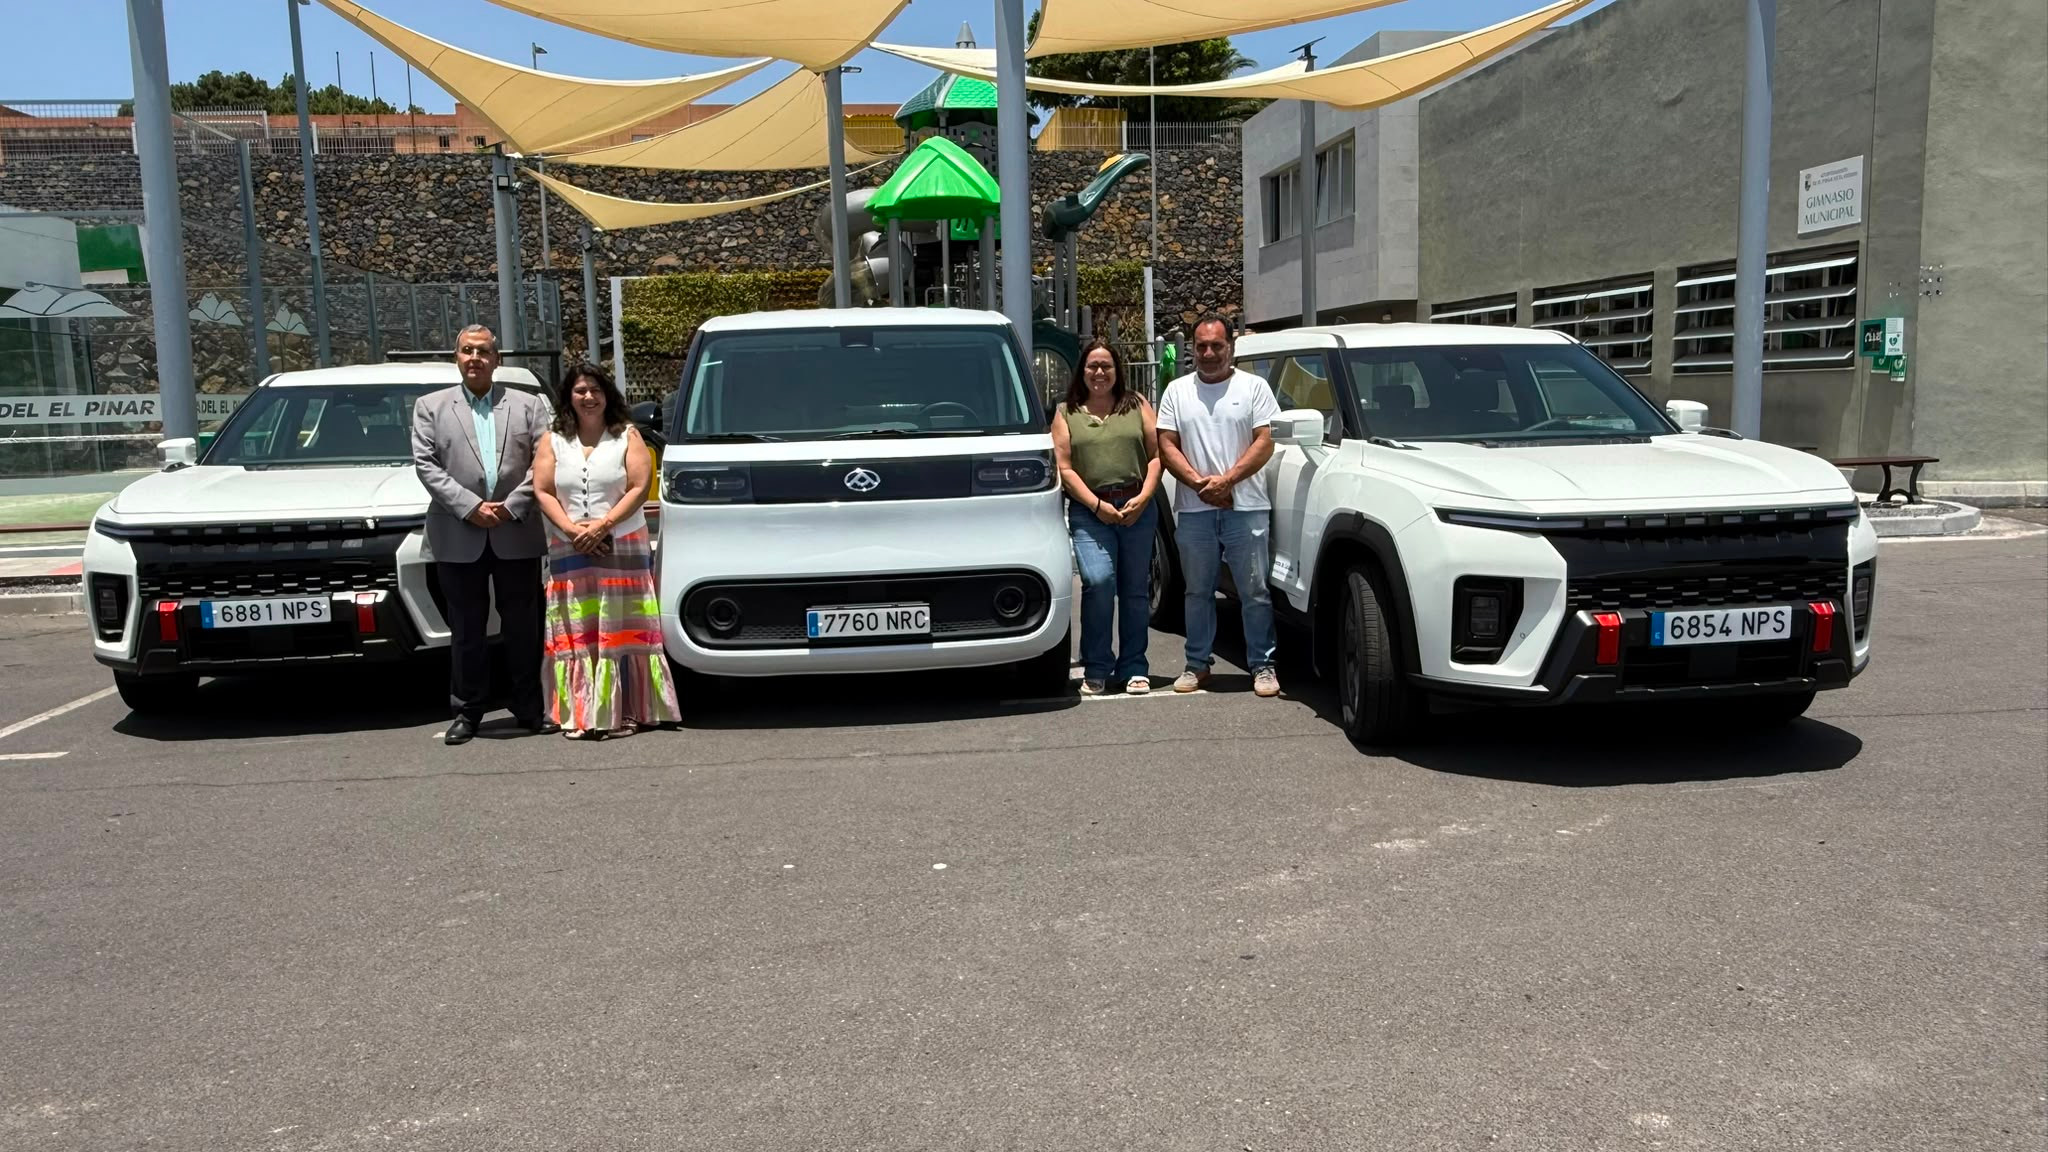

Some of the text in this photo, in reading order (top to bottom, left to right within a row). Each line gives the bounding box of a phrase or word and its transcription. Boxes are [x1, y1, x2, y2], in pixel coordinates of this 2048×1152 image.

[1806, 188, 1854, 209] GIMNASIO
[1804, 206, 1855, 225] MUNICIPAL
[48, 402, 75, 417] EL
[85, 400, 155, 416] PINAR
[220, 400, 230, 414] EL
[222, 601, 322, 623] 6881 NPS
[824, 610, 926, 633] 7760 NRC
[1670, 613, 1732, 639] 6854
[1741, 610, 1785, 636] NPS
